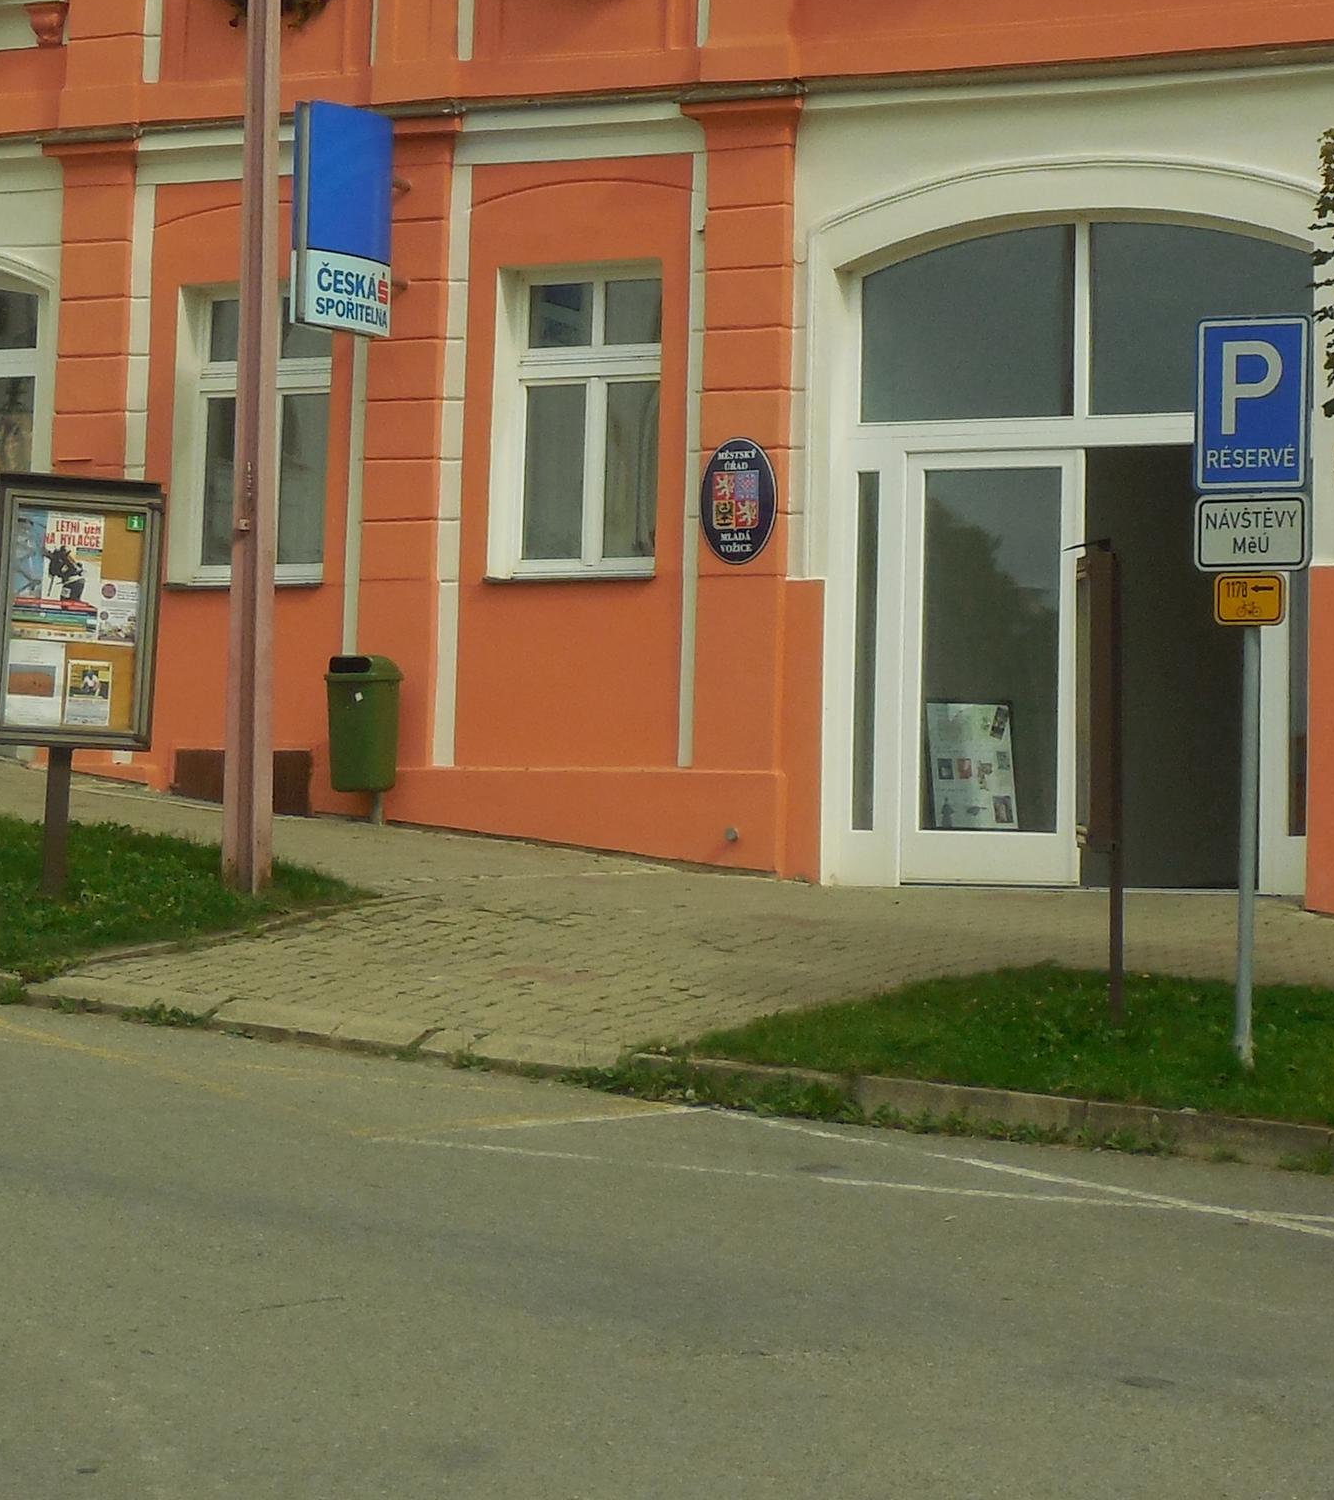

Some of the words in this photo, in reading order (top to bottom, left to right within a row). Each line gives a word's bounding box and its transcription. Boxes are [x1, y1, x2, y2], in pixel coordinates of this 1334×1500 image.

[317, 261, 377, 302] ČESKÁ
[315, 296, 388, 329] SPOŘITELNA
[1220, 339, 1284, 436] P
[717, 449, 757, 461] MĚSTSKÝ
[1206, 444, 1296, 469] RÉSERVÉ
[1205, 508, 1297, 530] NÁVŠTĚVY
[720, 530, 751, 541] MLADÁ
[1232, 532, 1270, 554] MěÚ
[720, 542, 753, 553] VOŽICE
